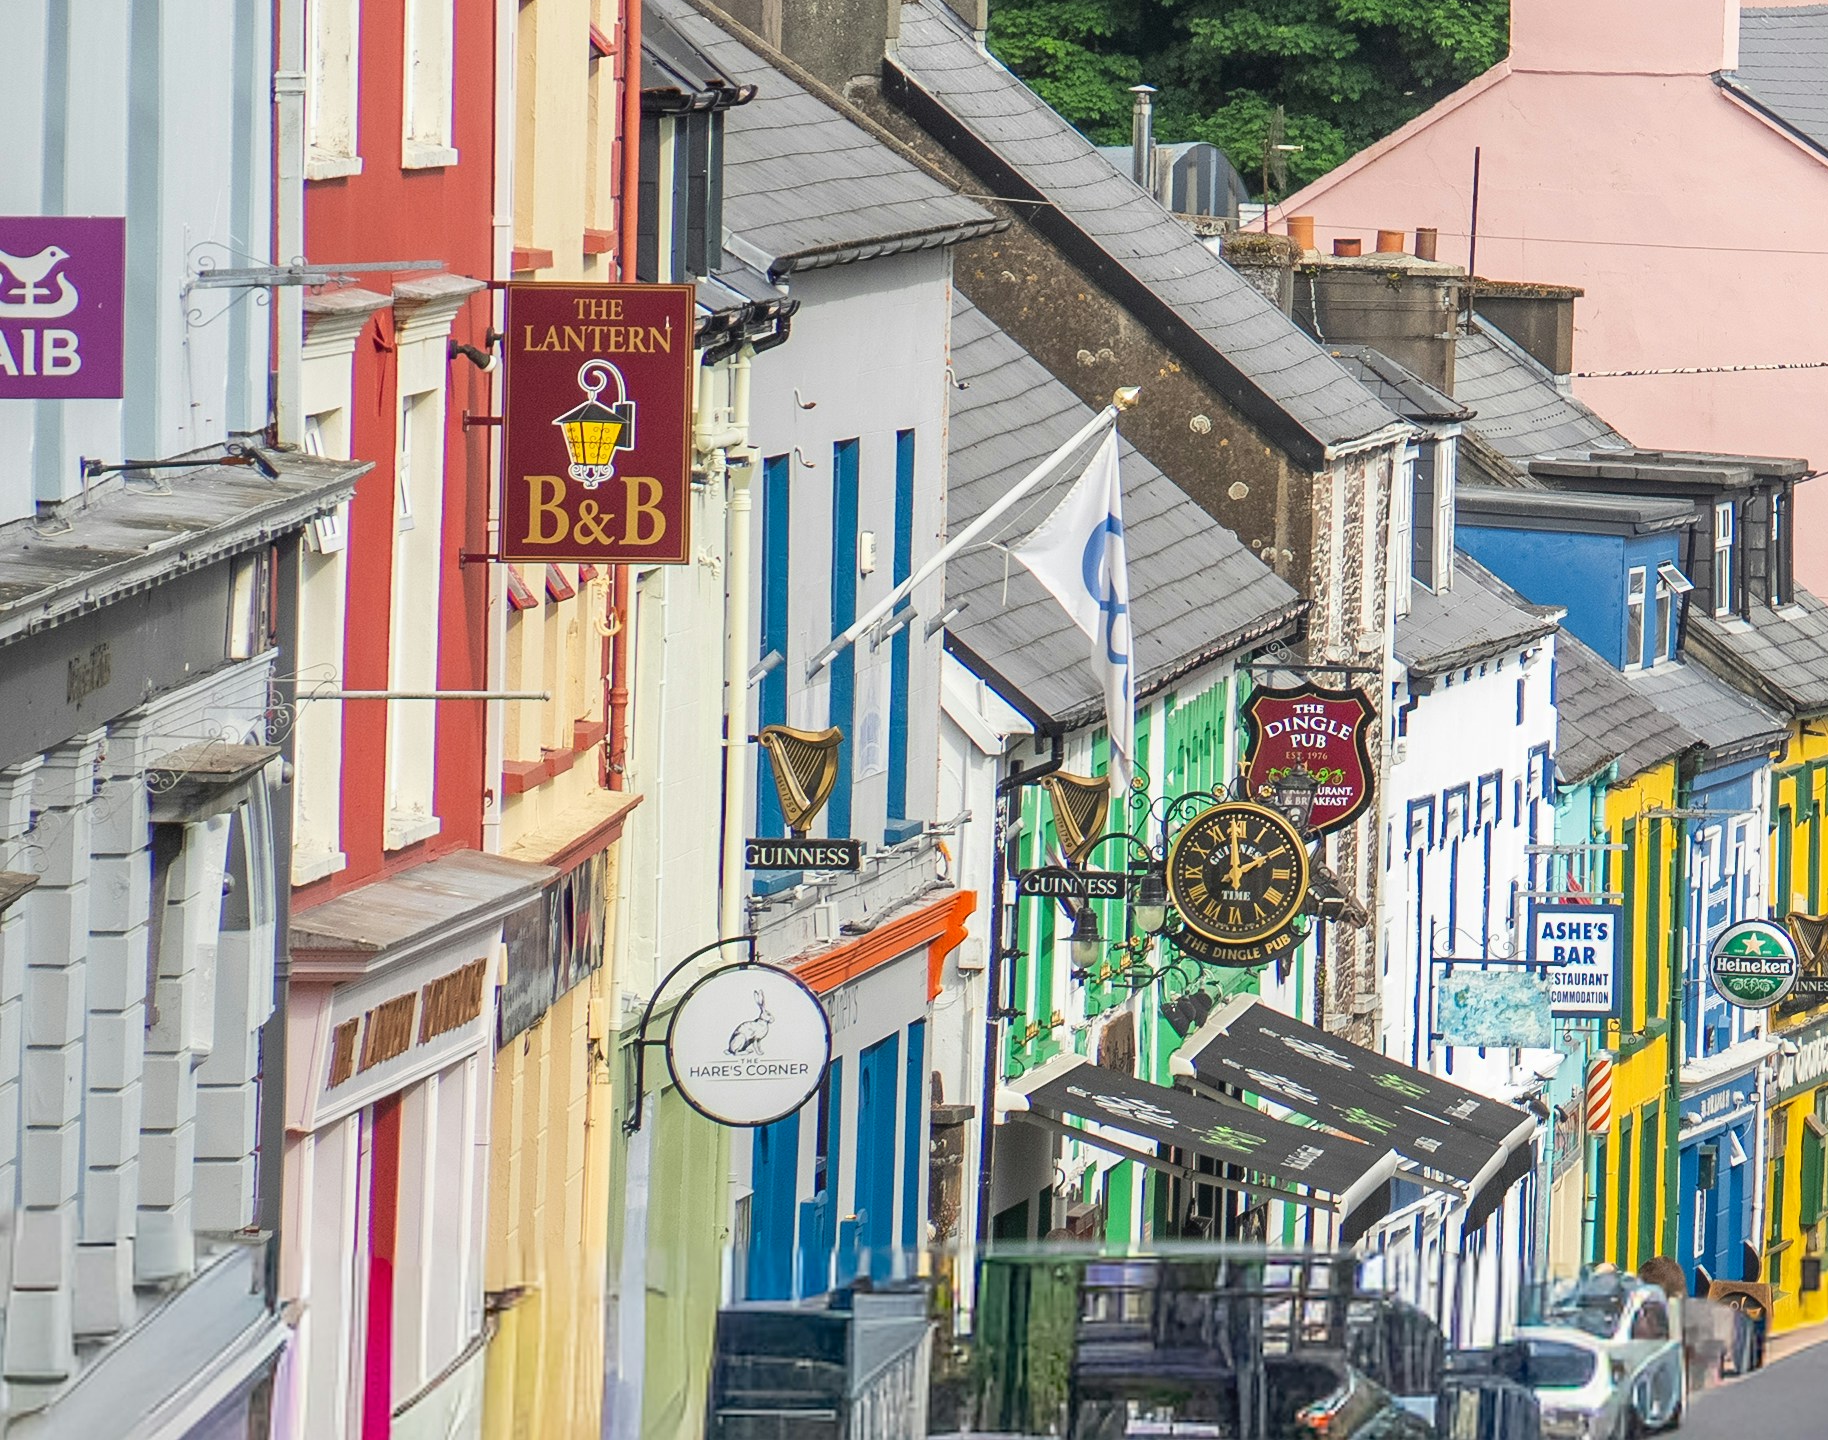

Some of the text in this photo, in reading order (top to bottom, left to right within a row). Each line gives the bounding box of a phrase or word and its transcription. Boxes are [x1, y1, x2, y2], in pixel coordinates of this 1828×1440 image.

[573, 298, 624, 320] THE
[523, 324, 673, 354] LANTERN
[521, 475, 667, 546] B&B
[1293, 704, 1325, 714] THE
[1264, 716, 1353, 741] DINGLE
[1290, 733, 1327, 748] PUB
[1307, 752, 1328, 760] 1976
[745, 844, 850, 866] GUINNESS
[1221, 890, 1251, 901] TIME
[1541, 922, 1608, 941] ASHE'S
[1184, 933, 1291, 960] THE DINGLE PUB
[1553, 946, 1596, 965] BAR
[1716, 957, 1791, 974] Heineken
[1551, 972, 1609, 986] STAURANT
[1551, 991, 1609, 1004] COMMODATION
[689, 1063, 809, 1078] HARE'S CORNER
